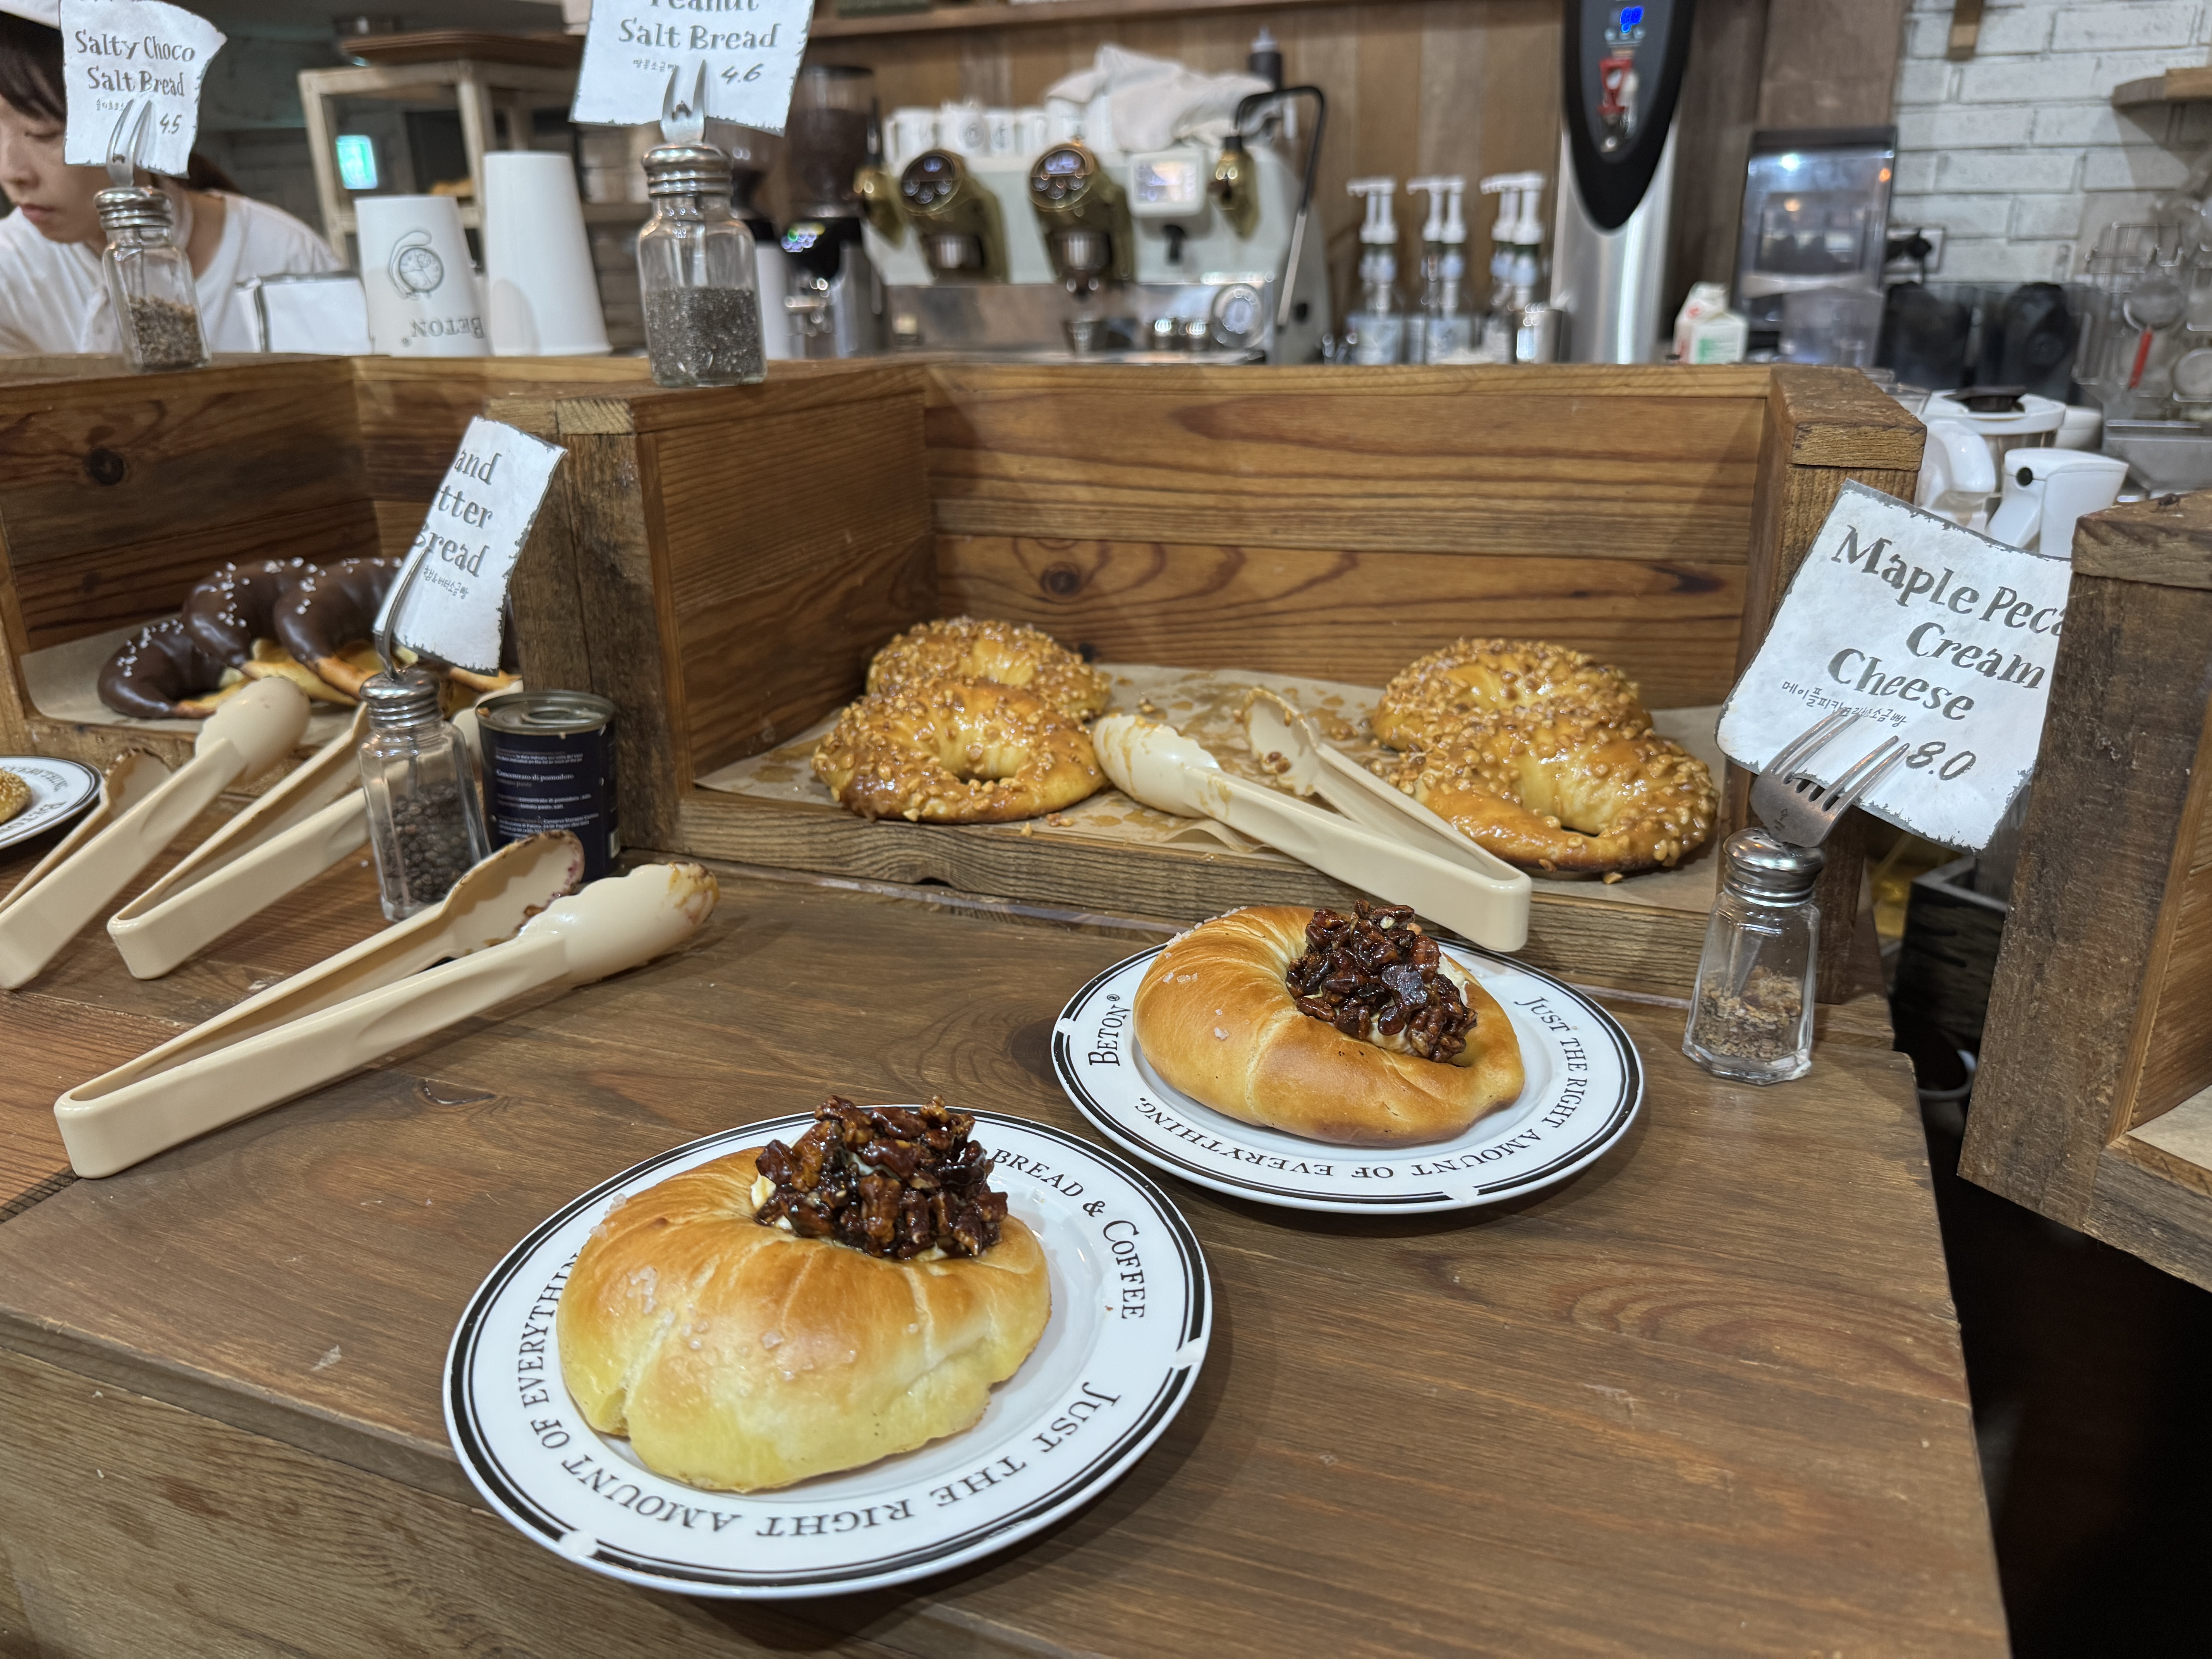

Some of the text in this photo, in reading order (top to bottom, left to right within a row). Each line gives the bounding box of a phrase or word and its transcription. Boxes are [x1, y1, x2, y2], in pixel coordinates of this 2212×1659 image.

[650, 0, 759, 12] eanut
[76, 29, 195, 62] Salty Choco
[618, 17, 781, 50] Salt Bread
[87, 65, 185, 97] Salt Bread
[721, 63, 764, 84] 4.6
[160, 113, 182, 134] 4.5
[454, 449, 503, 485] and
[438, 485, 493, 529] tter
[1831, 525, 1980, 615] Maple
[1906, 622, 2045, 689] Cream
[1827, 648, 1975, 720] Cheese
[541, 774, 574, 782] pomodoro
[1906, 741, 1977, 781] 8.0
[1135, 996, 1587, 1178] JUST THE RIGHT AMOUNT OF EVERYTHING.
[990, 1149, 1146, 1319] BREAD & COFFEE
[518, 1244, 1121, 1536] JUST THE RIGHT AMOUNT OF EVERYTHIN
